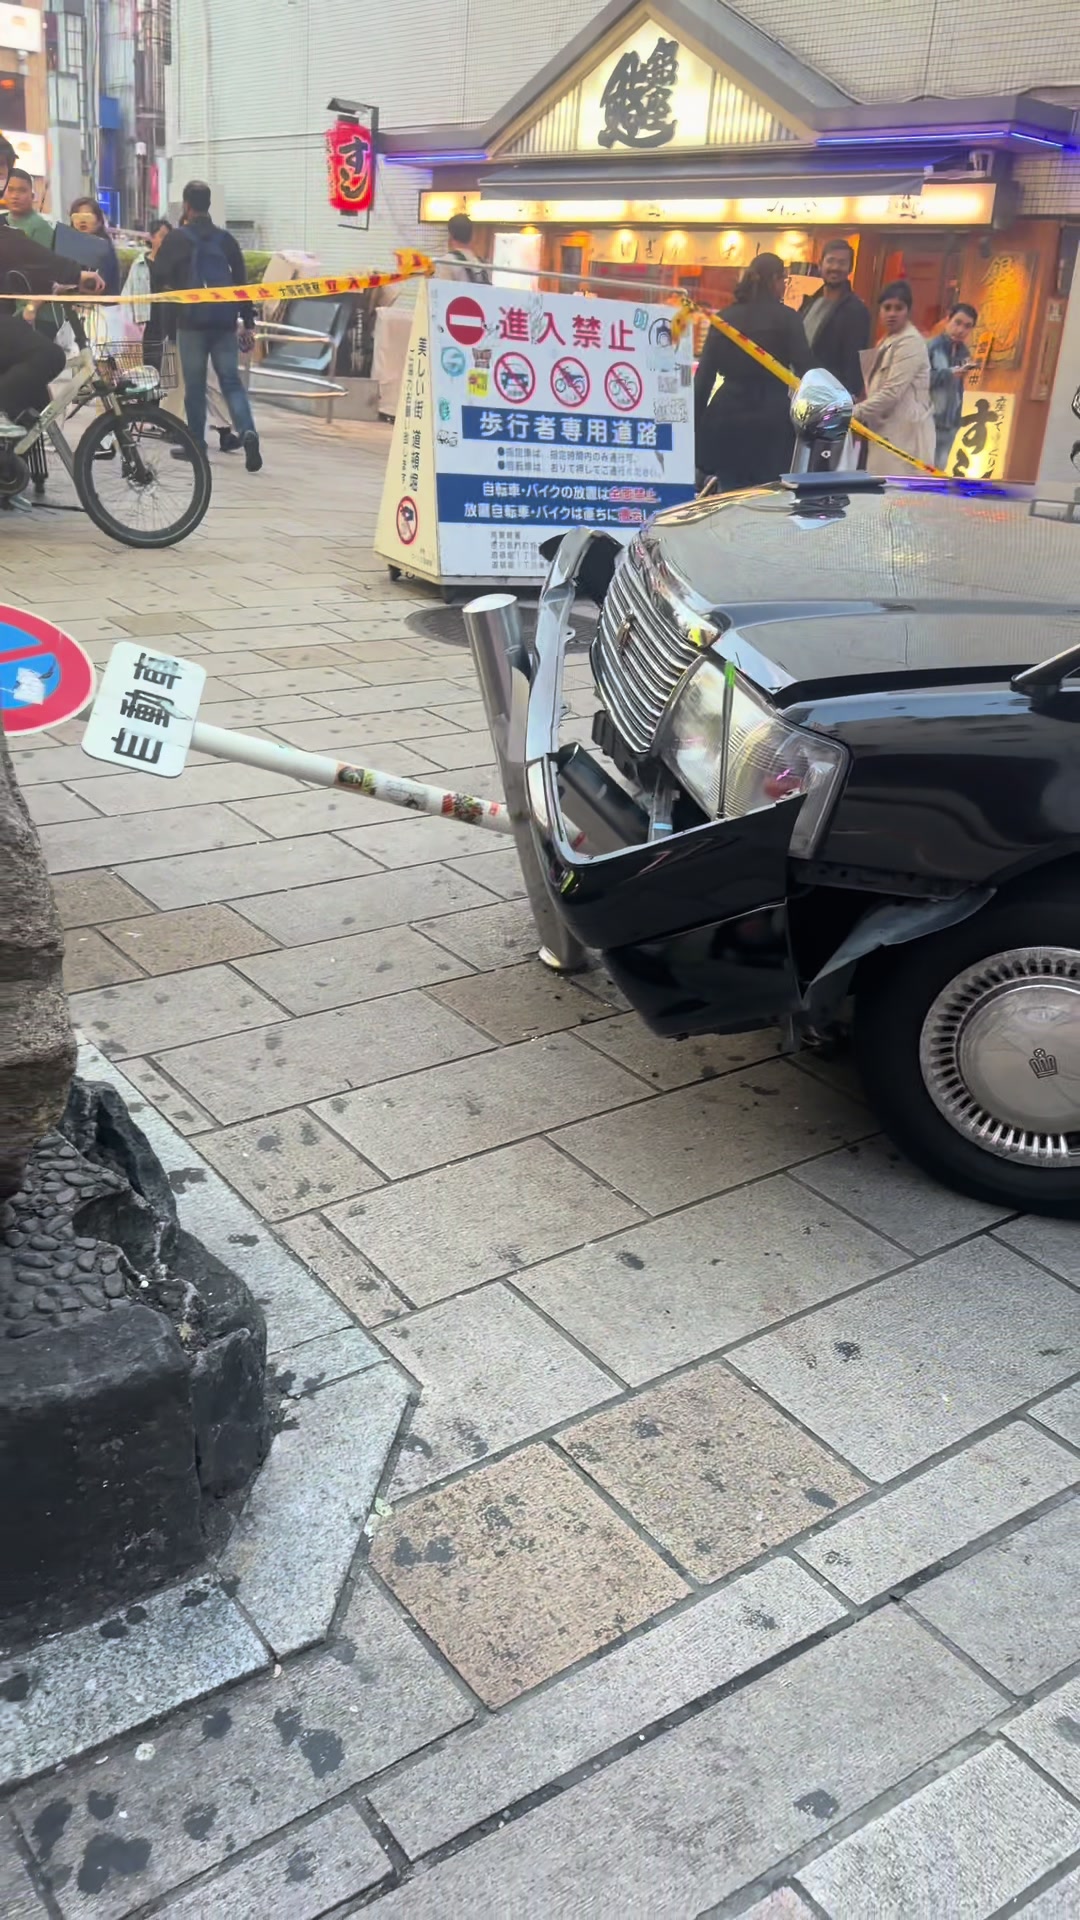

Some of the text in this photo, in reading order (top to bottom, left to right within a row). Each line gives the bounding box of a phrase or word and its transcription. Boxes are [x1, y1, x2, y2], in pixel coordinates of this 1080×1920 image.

[498, 307, 636, 352] 進入禁止
[479, 411, 658, 446] 歩行者専用道路
[111, 652, 182, 765] 自動車
